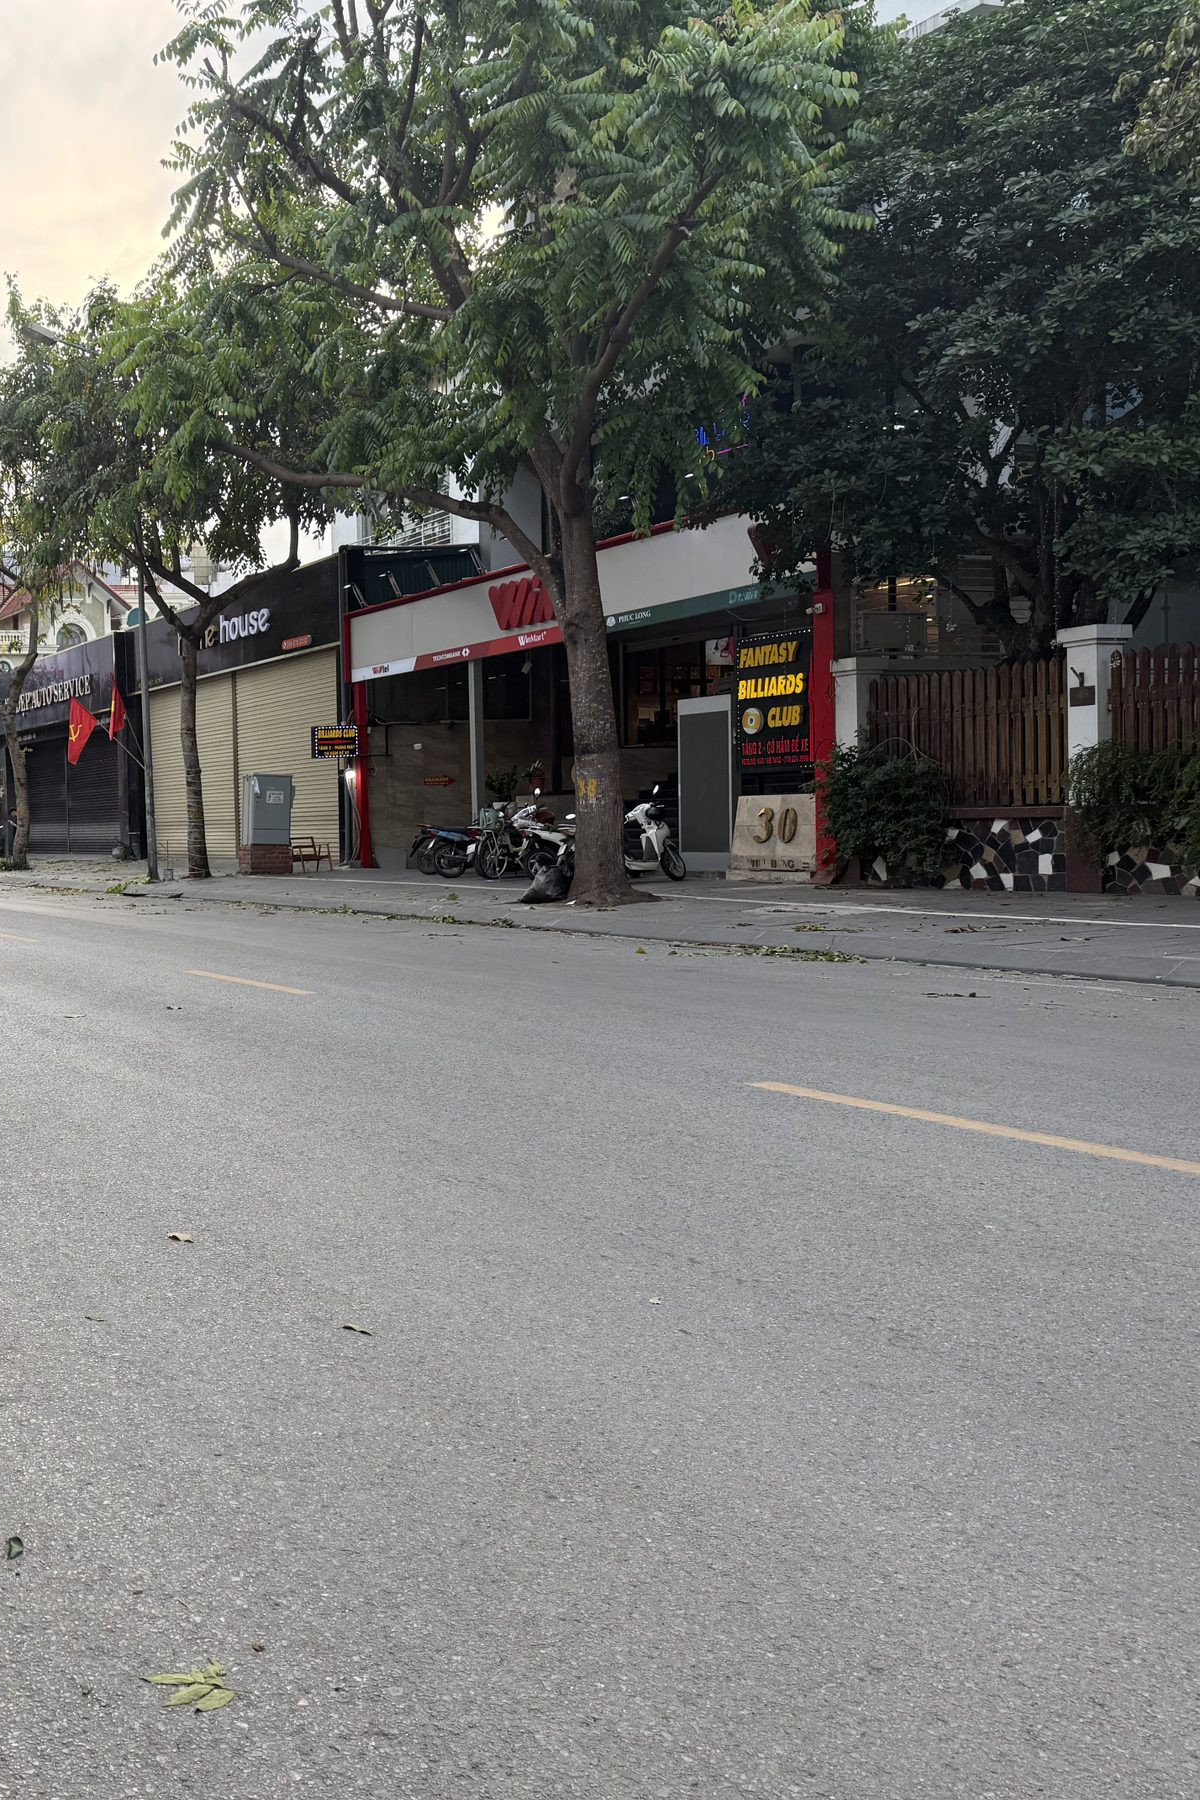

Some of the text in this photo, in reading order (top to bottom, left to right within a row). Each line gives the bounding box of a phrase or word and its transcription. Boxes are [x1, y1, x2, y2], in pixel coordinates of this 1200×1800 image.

[219, 608, 271, 643] house
[635, 610, 651, 620] LONG
[432, 650, 461, 662] TECHCOMBANK
[740, 641, 799, 669] FANTASY
[31, 685, 53, 709] AUTO
[53, 674, 91, 703] SERVICE
[738, 672, 805, 700] BILLIARDS
[767, 704, 803, 728] CLUB
[318, 729, 356, 738] BILLIARDS CLUB
[758, 741, 763, 755] 2
[753, 807, 798, 844] 30
